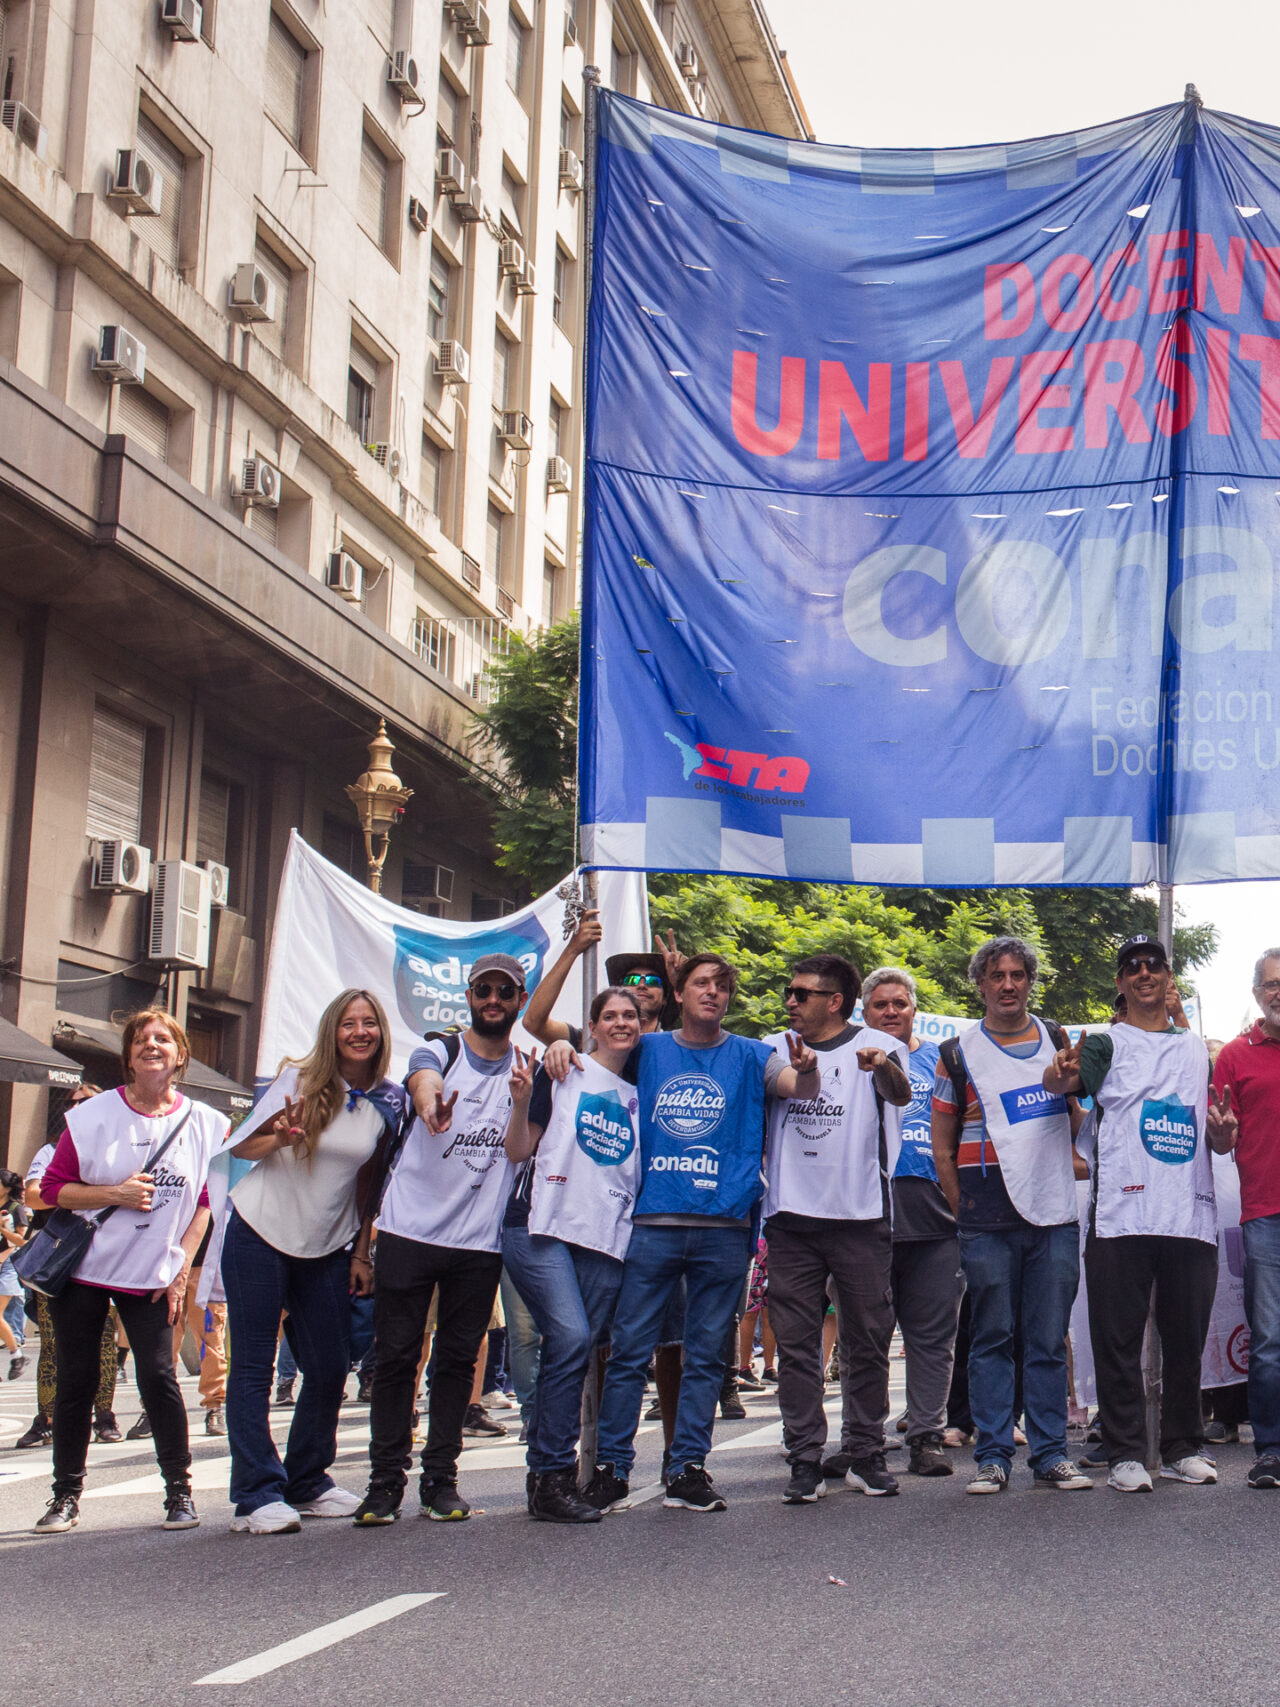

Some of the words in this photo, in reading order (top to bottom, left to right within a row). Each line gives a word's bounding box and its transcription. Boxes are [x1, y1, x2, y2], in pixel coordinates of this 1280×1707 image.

[693, 743, 810, 793] CTA
[694, 781, 710, 791] de
[713, 783, 729, 795] los
[731, 789, 806, 807] trabajadores
[652, 1088, 726, 1123] pública
[1017, 1090, 1062, 1108] ADUN
[658, 1108, 691, 1117] CAMBIA
[694, 1110, 720, 1119] VIDAS
[782, 1097, 845, 1128] pública
[788, 1116, 816, 1126] CAMBIA
[581, 1110, 631, 1140] aduna
[1144, 1115, 1195, 1137] aduna
[583, 1127, 625, 1151] asociación
[586, 1139, 620, 1159] docente
[1147, 1134, 1193, 1148] asociación
[1152, 1142, 1189, 1156] docente
[455, 1148, 486, 1158] CAMBIA
[157, 1189, 183, 1198] VIDAS
